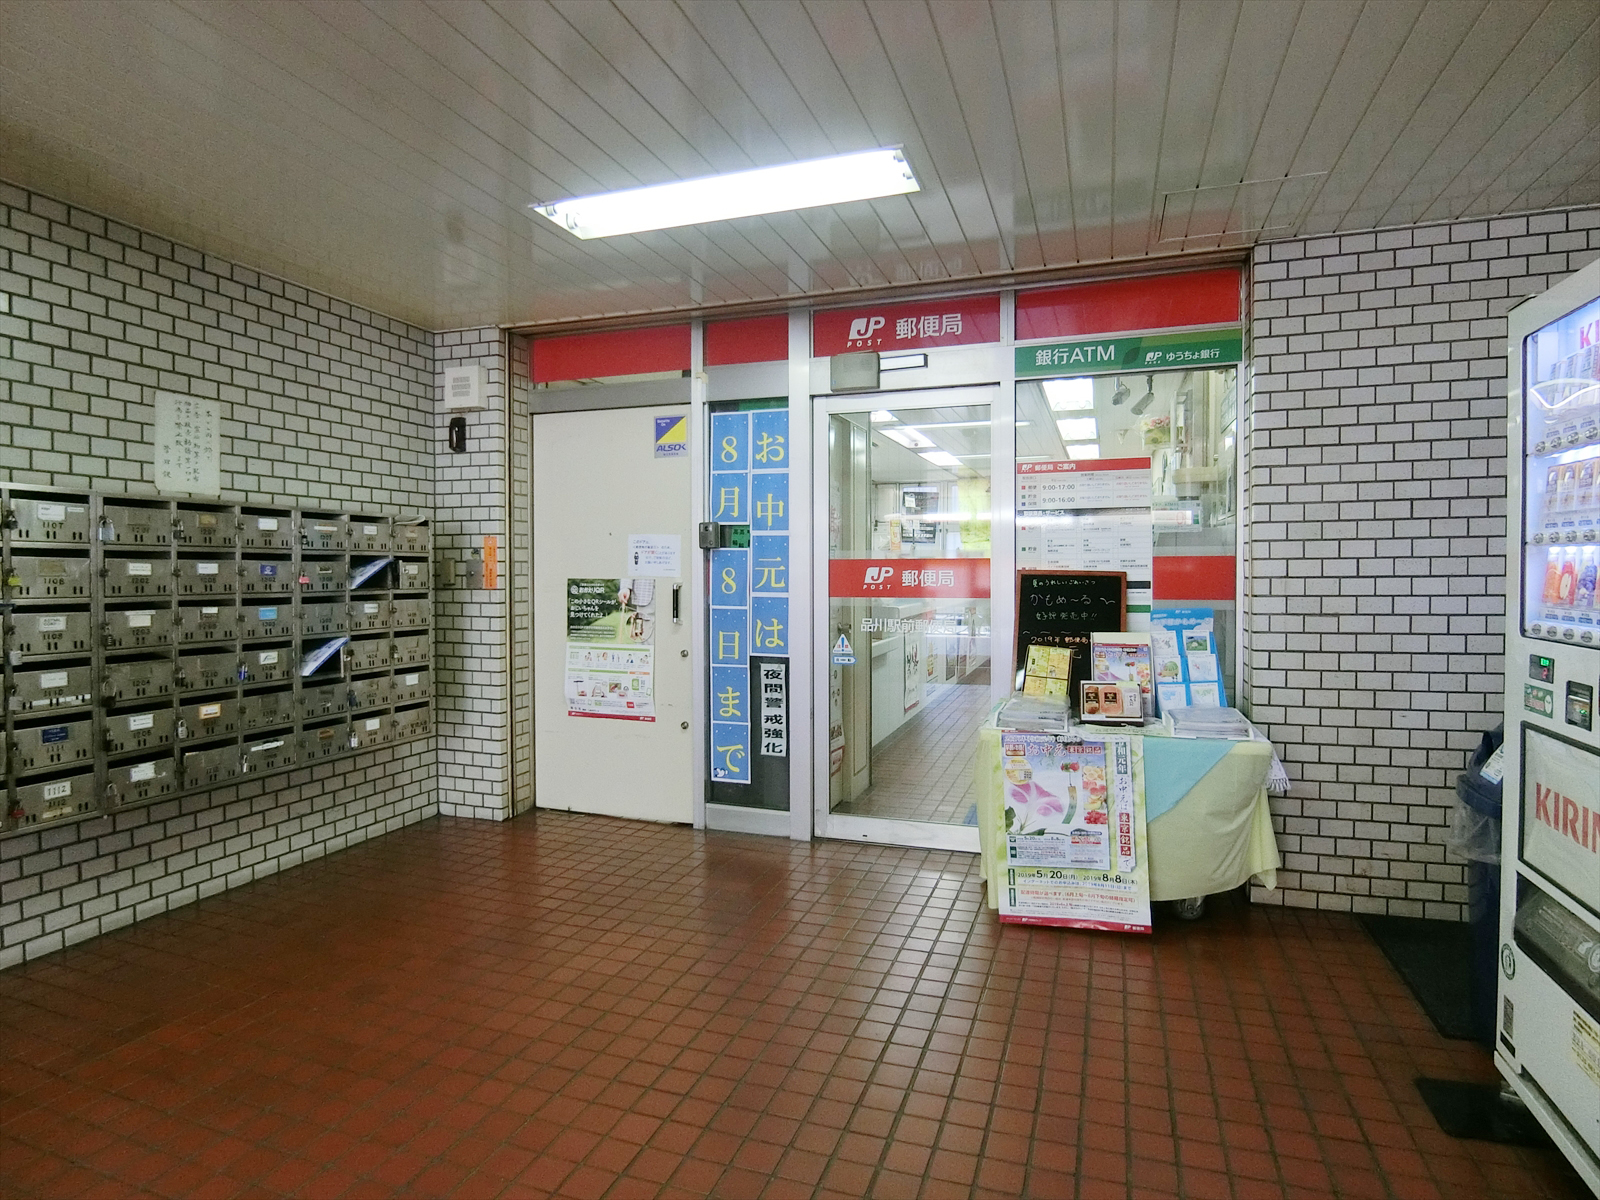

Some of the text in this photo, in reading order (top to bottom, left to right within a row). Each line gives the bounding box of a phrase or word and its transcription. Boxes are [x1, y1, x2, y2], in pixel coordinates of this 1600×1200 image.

[848, 316, 886, 340] JP
[895, 313, 963, 340] 郵便局
[846, 338, 883, 348] POST
[1035, 344, 1115, 366] 銀行ATM
[1165, 348, 1220, 361] ゆうちょ銀行
[656, 443, 687, 452] ALSOK
[1034, 462, 1076, 471] 郵便局 ご案内
[42, 521, 65, 530] 1107
[755, 431, 786, 648] お中元は
[864, 566, 894, 584] JP
[901, 569, 955, 588] 郵便局
[715, 435, 745, 773] 8月8日まで
[860, 617, 957, 633] 品川駅前郵便局
[1064, 636, 1092, 645] 郵便局
[763, 668, 784, 754] 夜間警戒強化
[47, 785, 67, 796] 1112
[1017, 869, 1078, 880] 2019年5月20日(月)
[1083, 872, 1139, 885] 2019年8月8日(木)
